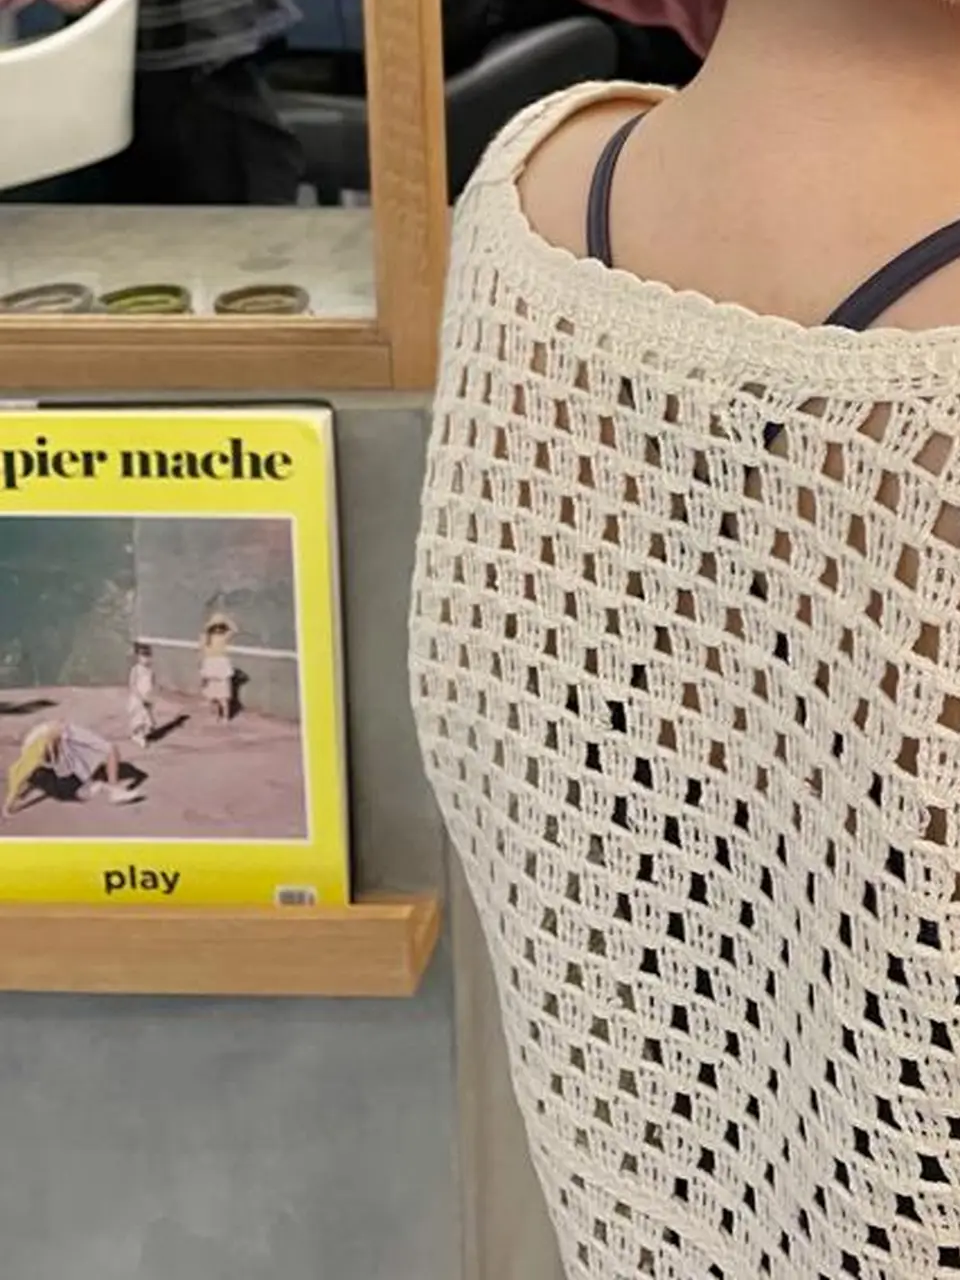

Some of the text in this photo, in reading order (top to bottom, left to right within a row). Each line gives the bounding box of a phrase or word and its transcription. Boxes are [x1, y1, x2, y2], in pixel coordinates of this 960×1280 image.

[0, 436, 293, 490] pier mache
[103, 864, 180, 894] play
